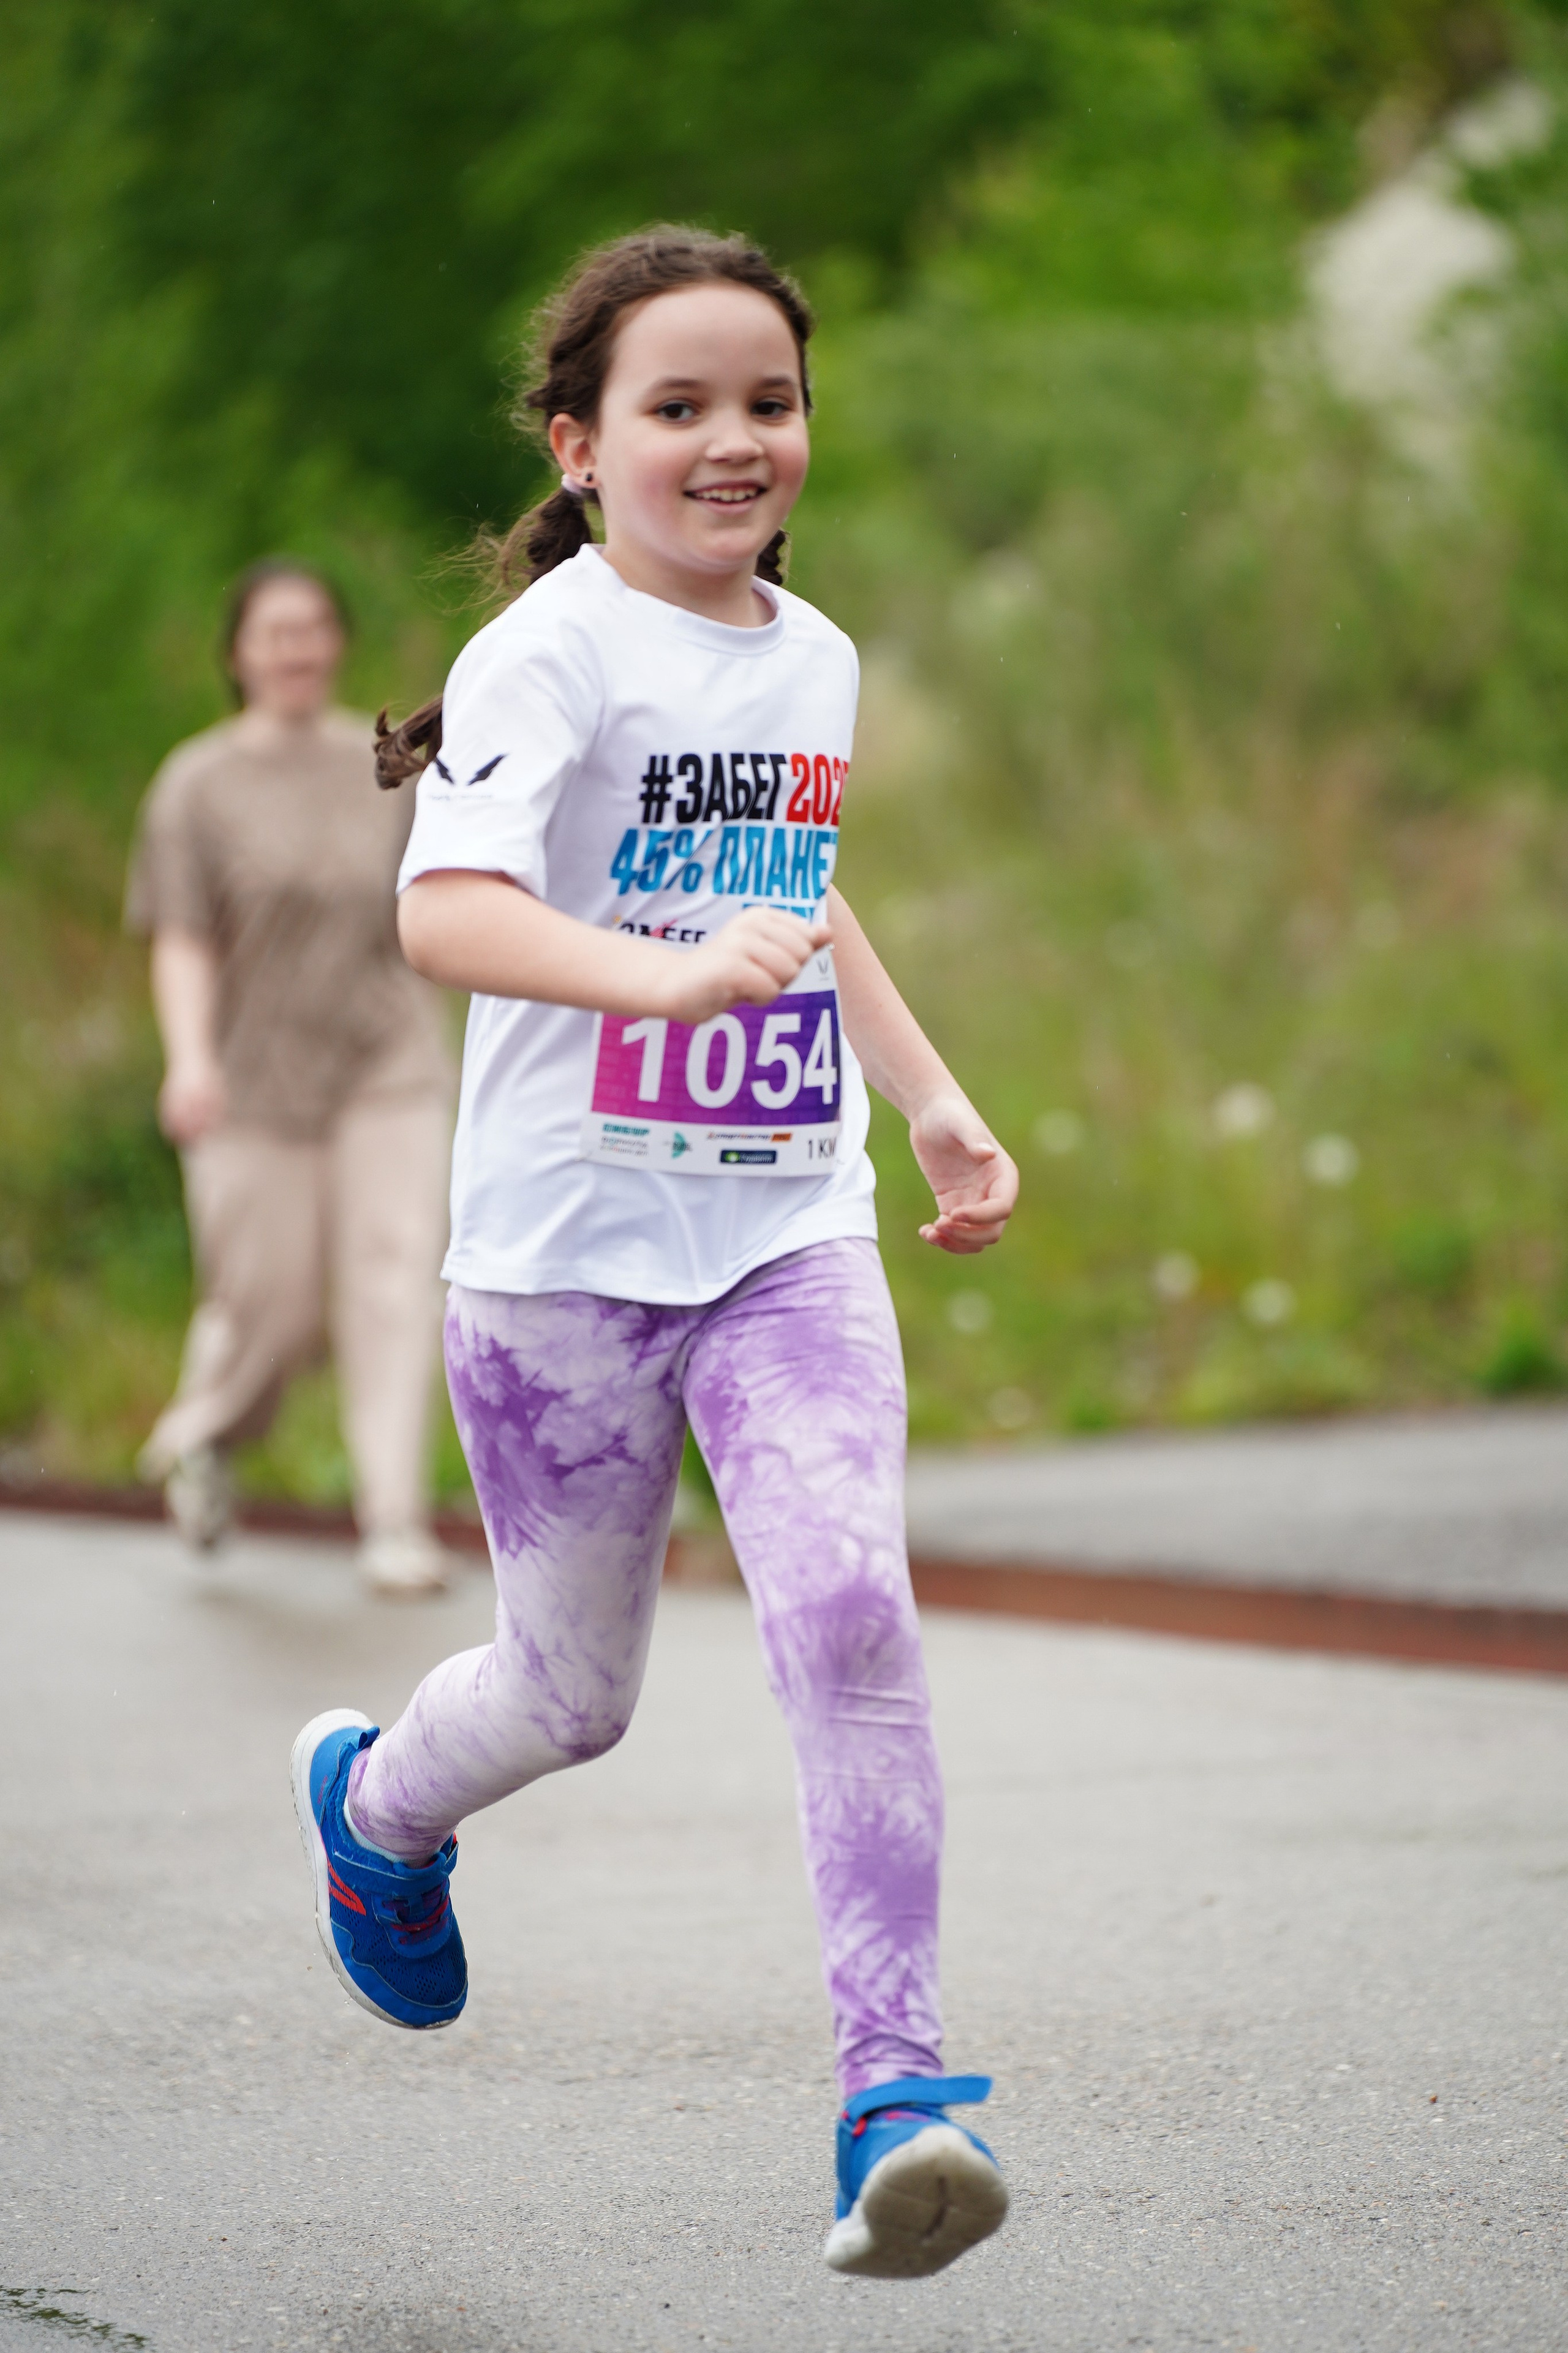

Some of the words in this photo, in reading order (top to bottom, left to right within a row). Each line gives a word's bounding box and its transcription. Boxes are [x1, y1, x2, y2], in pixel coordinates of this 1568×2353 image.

[639, 753, 849, 826] #ЗАБЕГ202
[610, 829, 714, 896] 45%
[711, 826, 839, 900] ПЛАНЕ
[622, 1008, 839, 1110] 1054
[807, 1138, 813, 1159] 1
